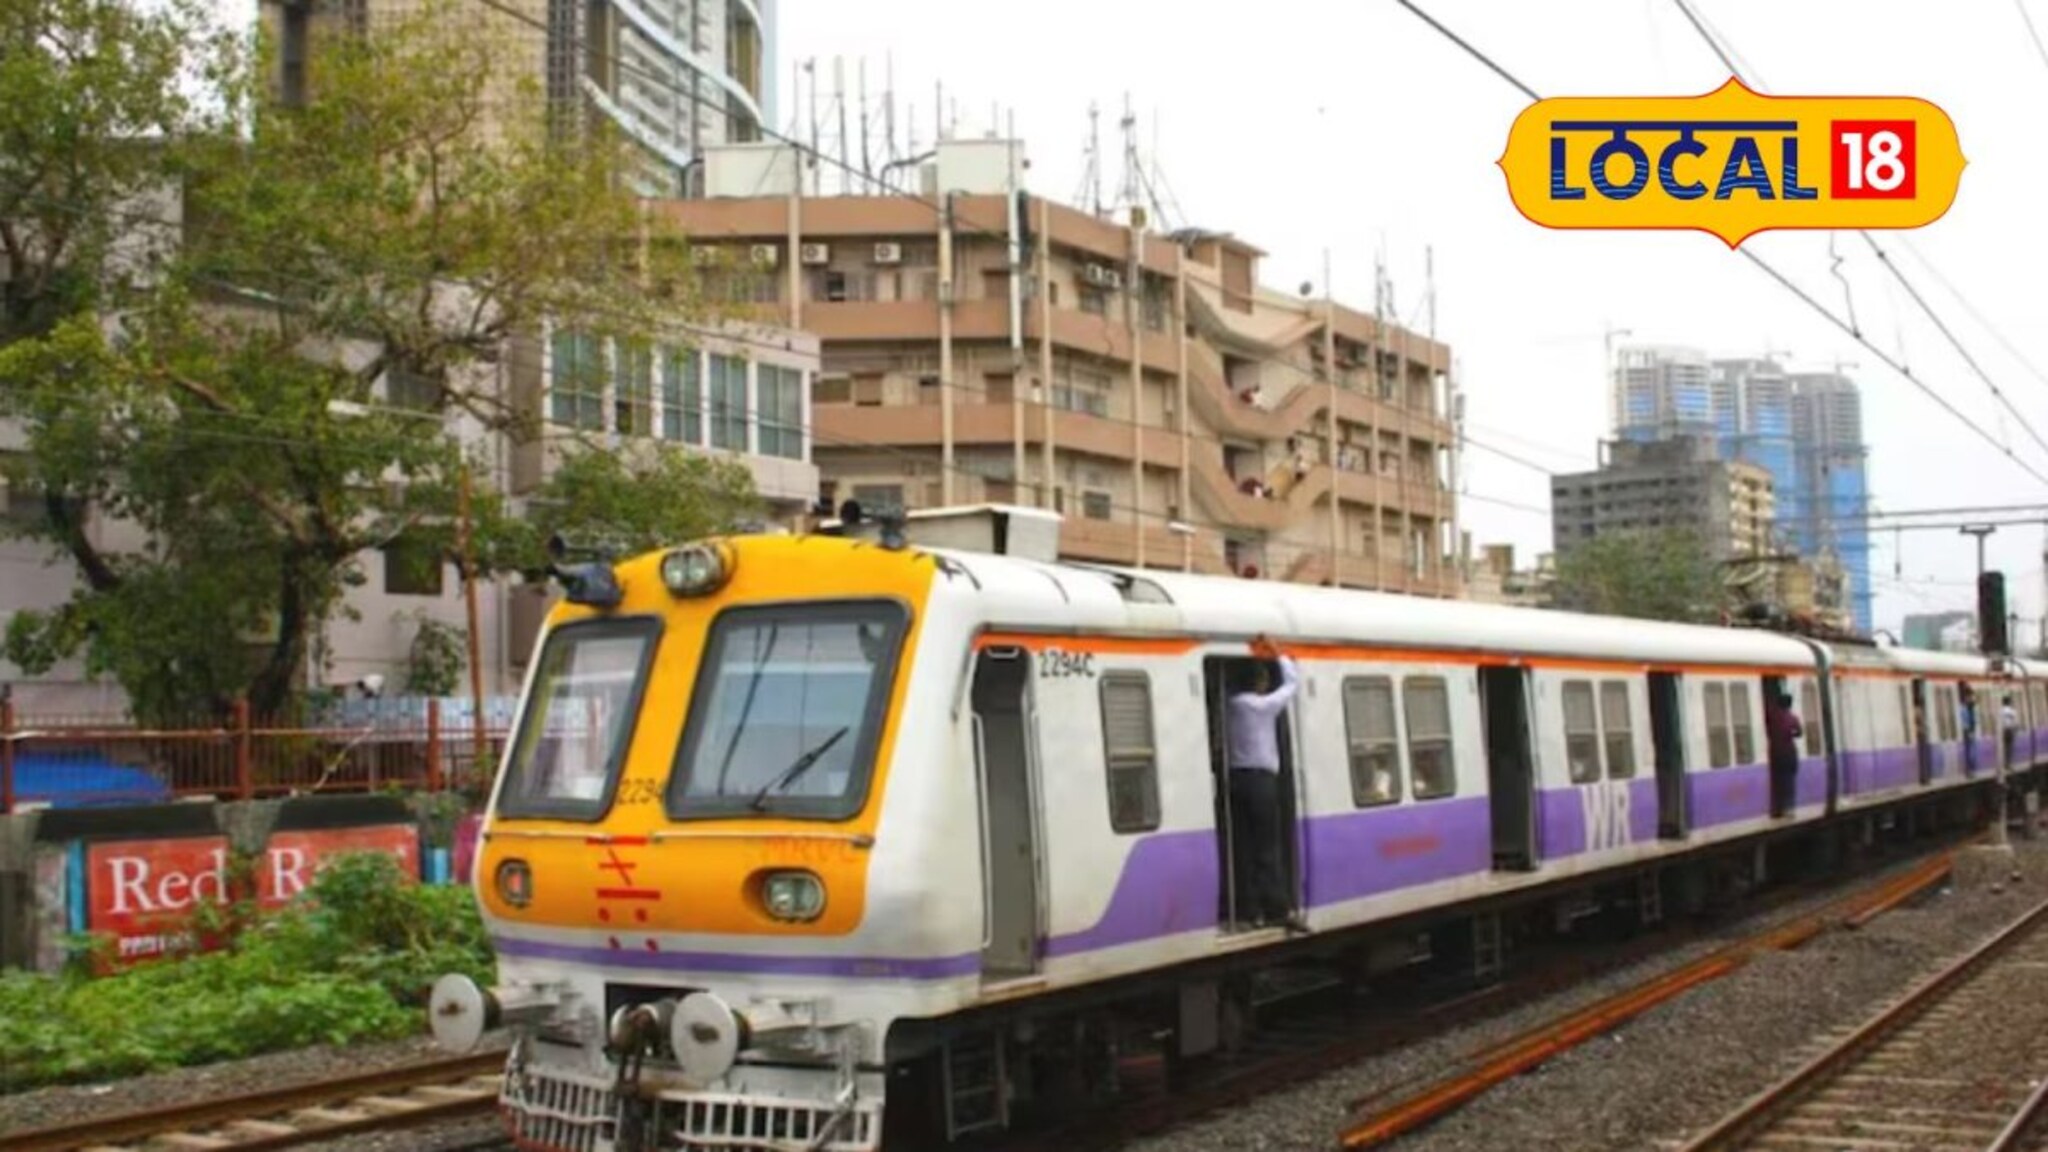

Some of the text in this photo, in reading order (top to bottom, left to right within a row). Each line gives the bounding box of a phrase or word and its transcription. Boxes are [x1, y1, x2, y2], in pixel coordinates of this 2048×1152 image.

[1039, 649, 1095, 679] 2294C
[1581, 785, 1631, 853] WR
[107, 848, 228, 915] Red
